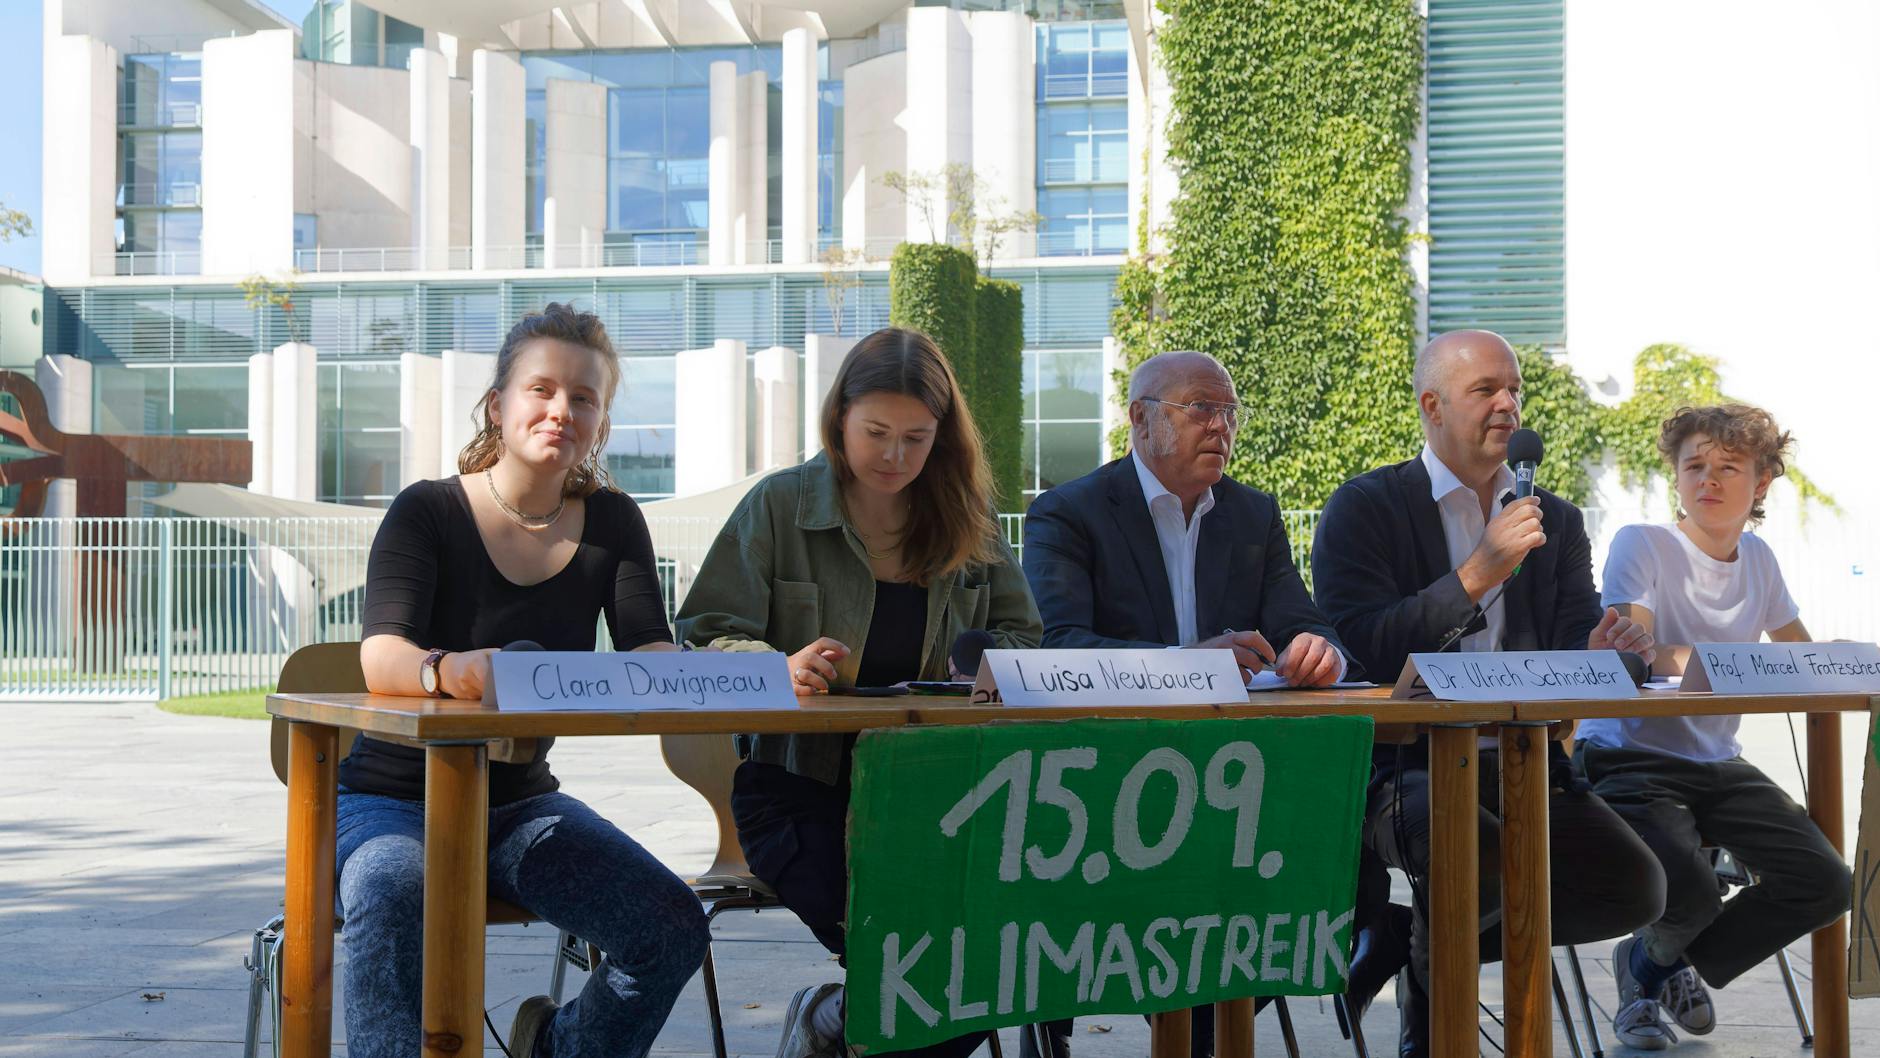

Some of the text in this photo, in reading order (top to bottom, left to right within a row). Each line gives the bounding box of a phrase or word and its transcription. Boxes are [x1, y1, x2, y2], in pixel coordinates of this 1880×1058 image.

[533, 661, 767, 705] Clara Duvigneau
[1015, 658, 1219, 692] Luisa Neubauer
[1427, 664, 1464, 690] Dr.
[1462, 661, 1523, 688] Ulrich
[1524, 658, 1619, 688] Schneider
[1707, 652, 1744, 684] Prof.
[1750, 649, 1800, 677] Marcel
[939, 740, 1284, 884] 15.09.
[879, 906, 1355, 1040] KLIMASTREIK
